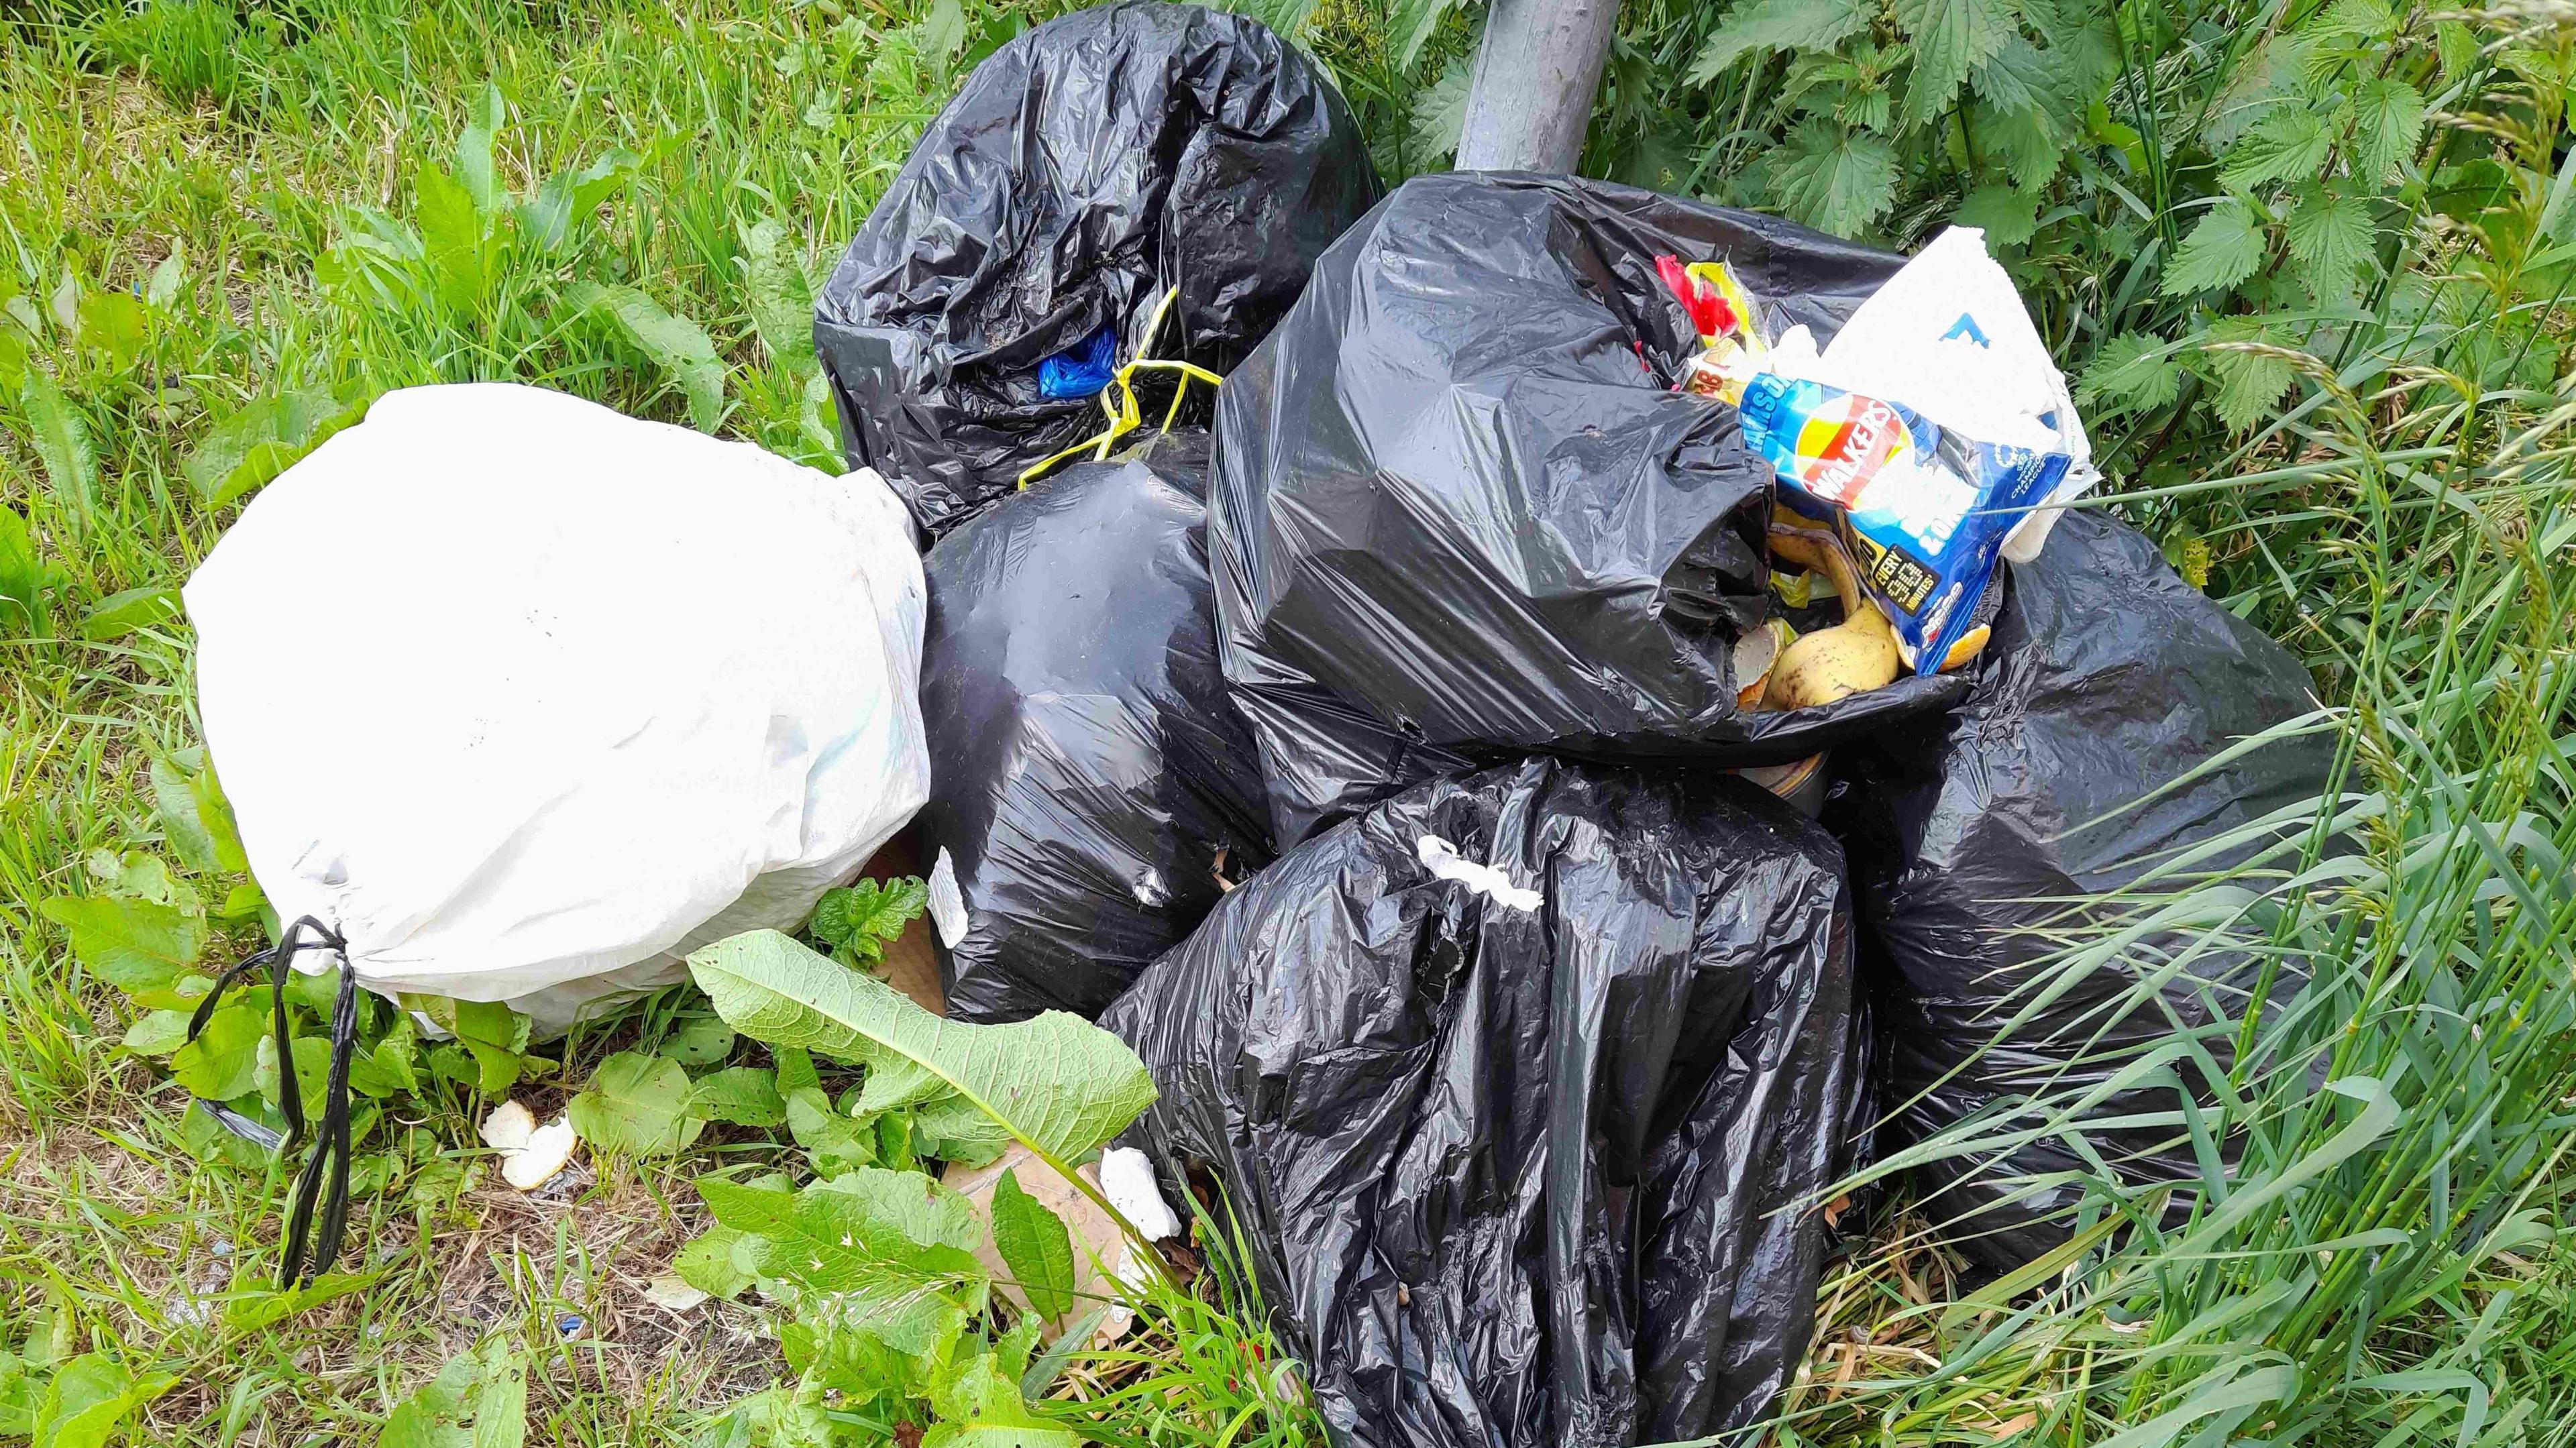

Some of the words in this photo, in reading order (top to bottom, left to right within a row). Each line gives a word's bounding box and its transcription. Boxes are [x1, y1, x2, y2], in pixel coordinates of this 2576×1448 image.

[1812, 400, 1892, 500] WALKERS
[2011, 455, 2044, 499] CHAMPIO
[2021, 457, 2047, 495] LEAGUE
[1875, 550, 1902, 586] EVERY
[1886, 562, 1924, 603] 90
